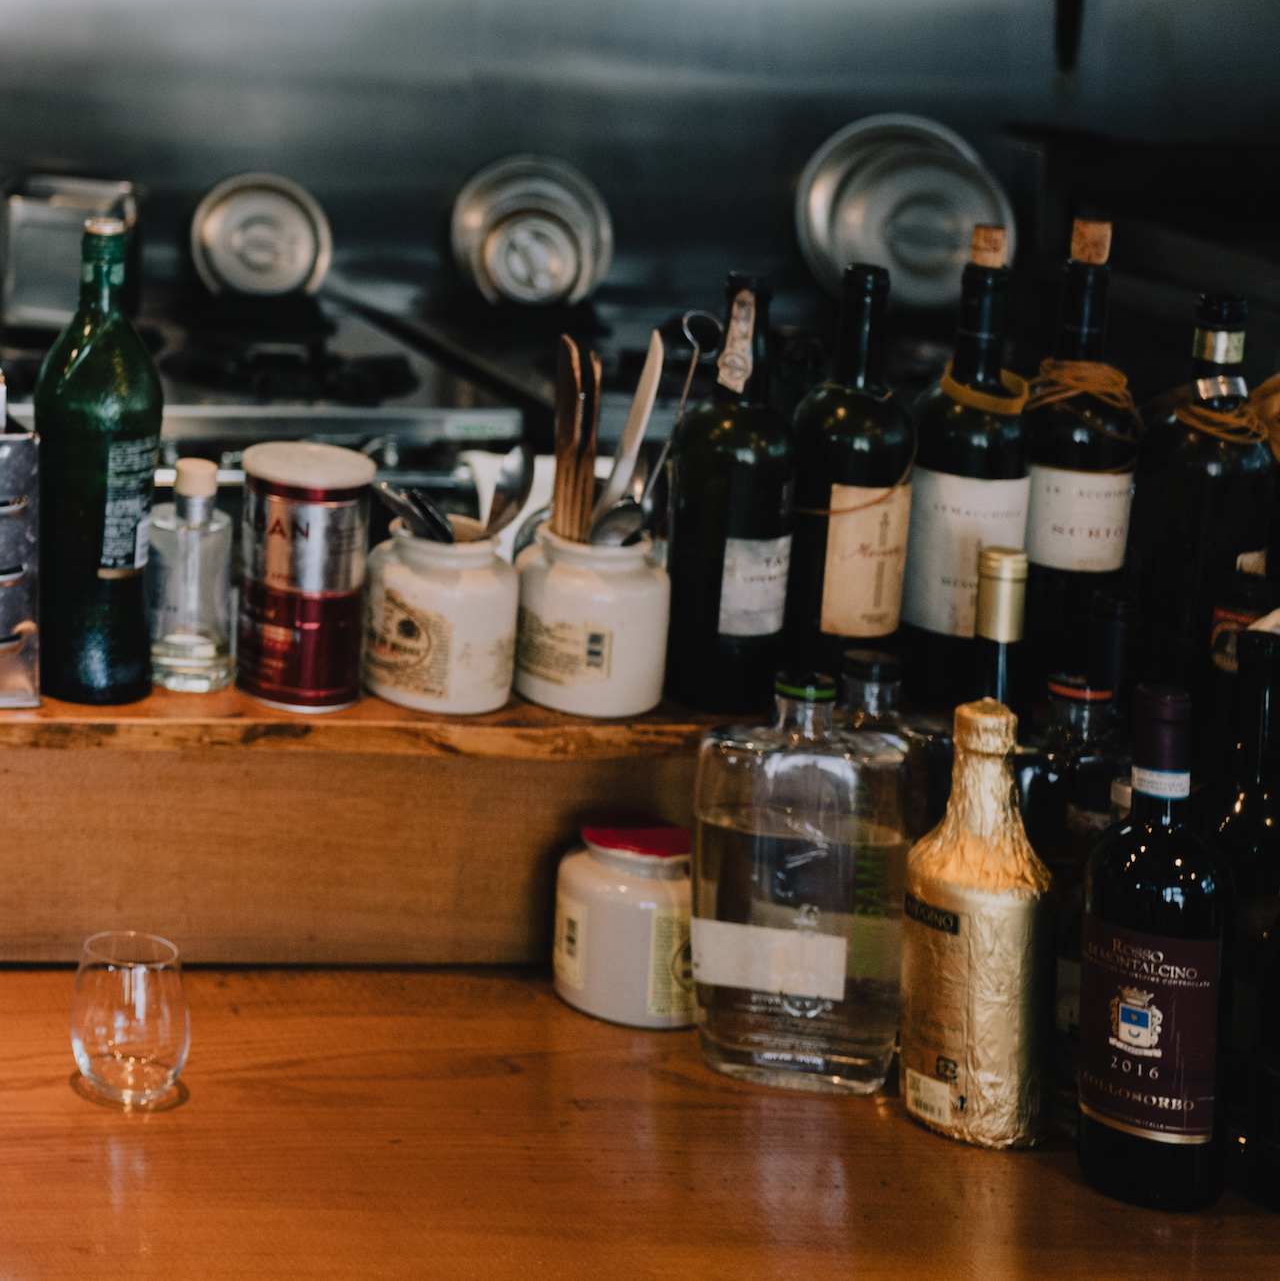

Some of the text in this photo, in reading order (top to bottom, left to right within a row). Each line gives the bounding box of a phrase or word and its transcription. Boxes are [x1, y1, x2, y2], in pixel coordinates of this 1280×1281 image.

[1112, 938, 1165, 964] ROSSO
[1100, 949, 1198, 981] MONTALCINO
[1109, 1055, 1160, 1080] 2016
